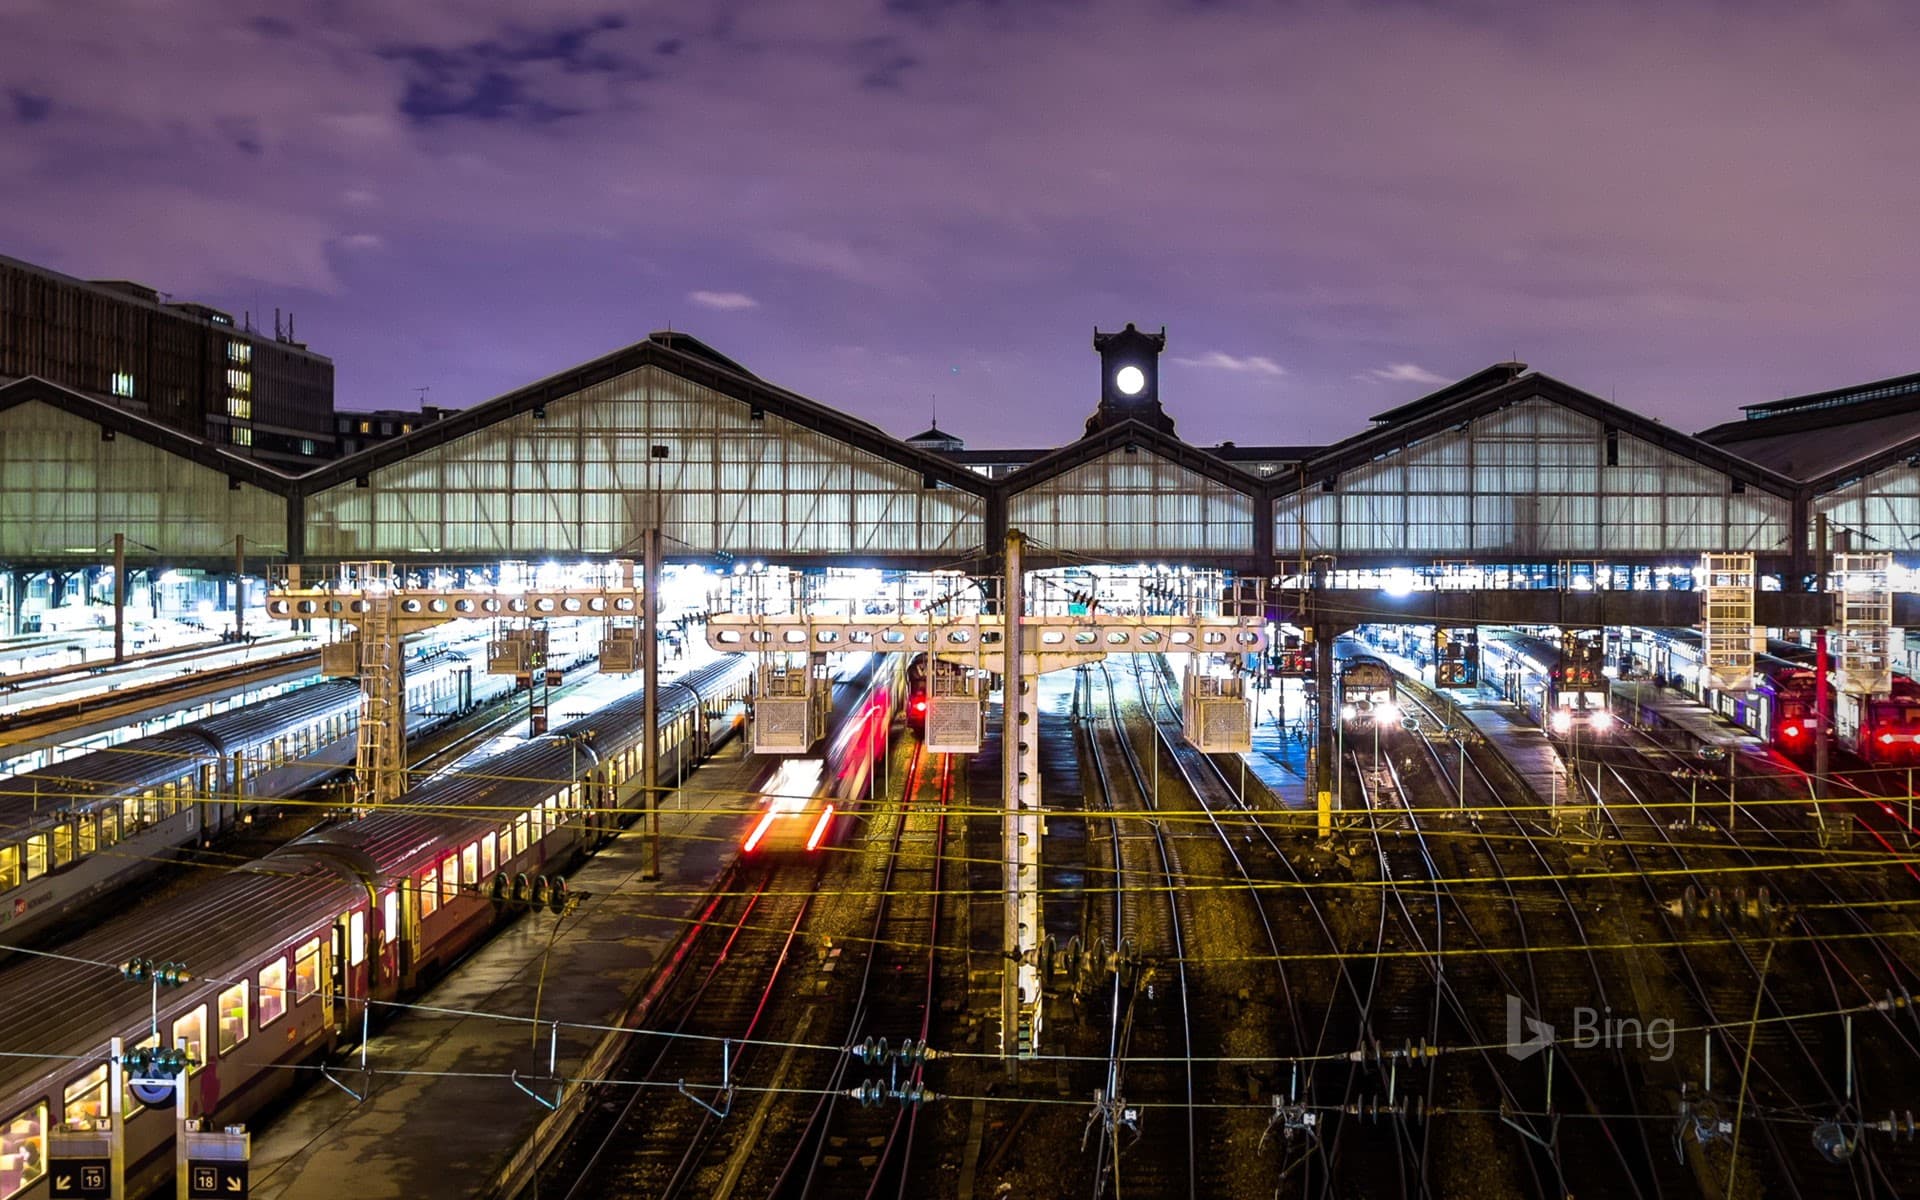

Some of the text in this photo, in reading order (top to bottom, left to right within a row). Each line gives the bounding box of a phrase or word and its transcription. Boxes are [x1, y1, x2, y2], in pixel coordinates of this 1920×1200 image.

[99, 1119, 106, 1128] T
[188, 1120, 195, 1129] T
[86, 1175, 101, 1187] 19
[198, 1176, 214, 1188] 18
